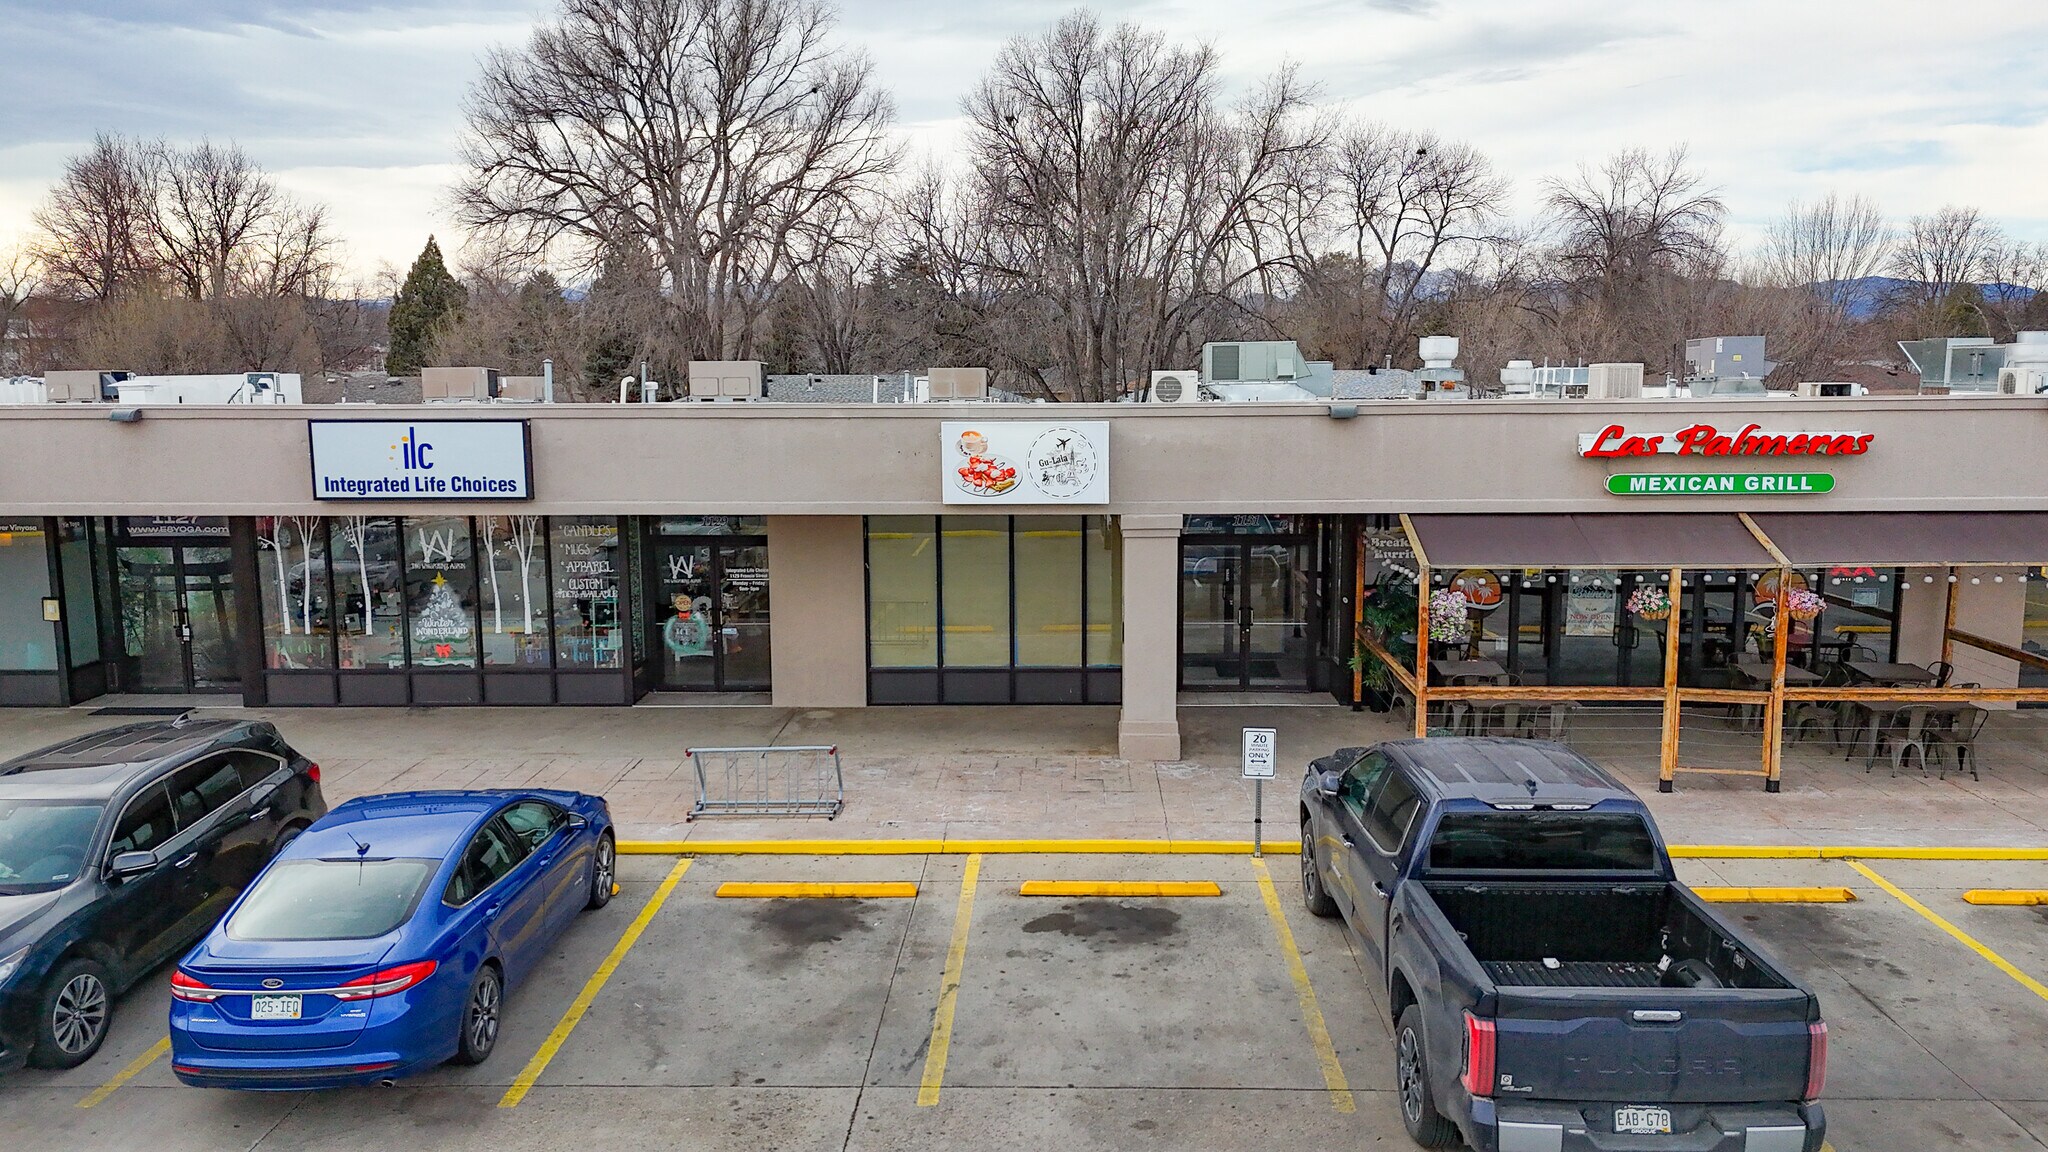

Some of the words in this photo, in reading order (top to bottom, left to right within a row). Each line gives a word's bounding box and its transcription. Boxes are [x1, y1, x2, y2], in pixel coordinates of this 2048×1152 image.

[1583, 424, 1664, 457] Las
[1673, 423, 1875, 457] Palmeras
[401, 426, 434, 469] ilc
[1038, 454, 1069, 468] Gu-Lala
[324, 476, 410, 496] Integrated
[414, 476, 446, 493] Life
[451, 475, 517, 493] Choices
[1629, 475, 1734, 492] MEXICAN
[1744, 475, 1813, 491] GRILL
[1232, 515, 1260, 527] 1131
[9, 523, 37, 533] Vinyasa
[127, 525, 229, 534] www.E8YOGA.com
[563, 524, 612, 537] CANDLES
[1371, 537, 1411, 547] Break
[565, 543, 591, 555] MUGS
[1374, 549, 1416, 559] Burrit
[566, 560, 614, 575] APPAREL
[568, 578, 603, 590] CUSTOM
[421, 617, 455, 628] Winter
[1570, 613, 1588, 621] NOW
[1590, 613, 1611, 621] OPEN
[416, 626, 468, 637] WONDERLAND
[1253, 735, 1267, 743] 20
